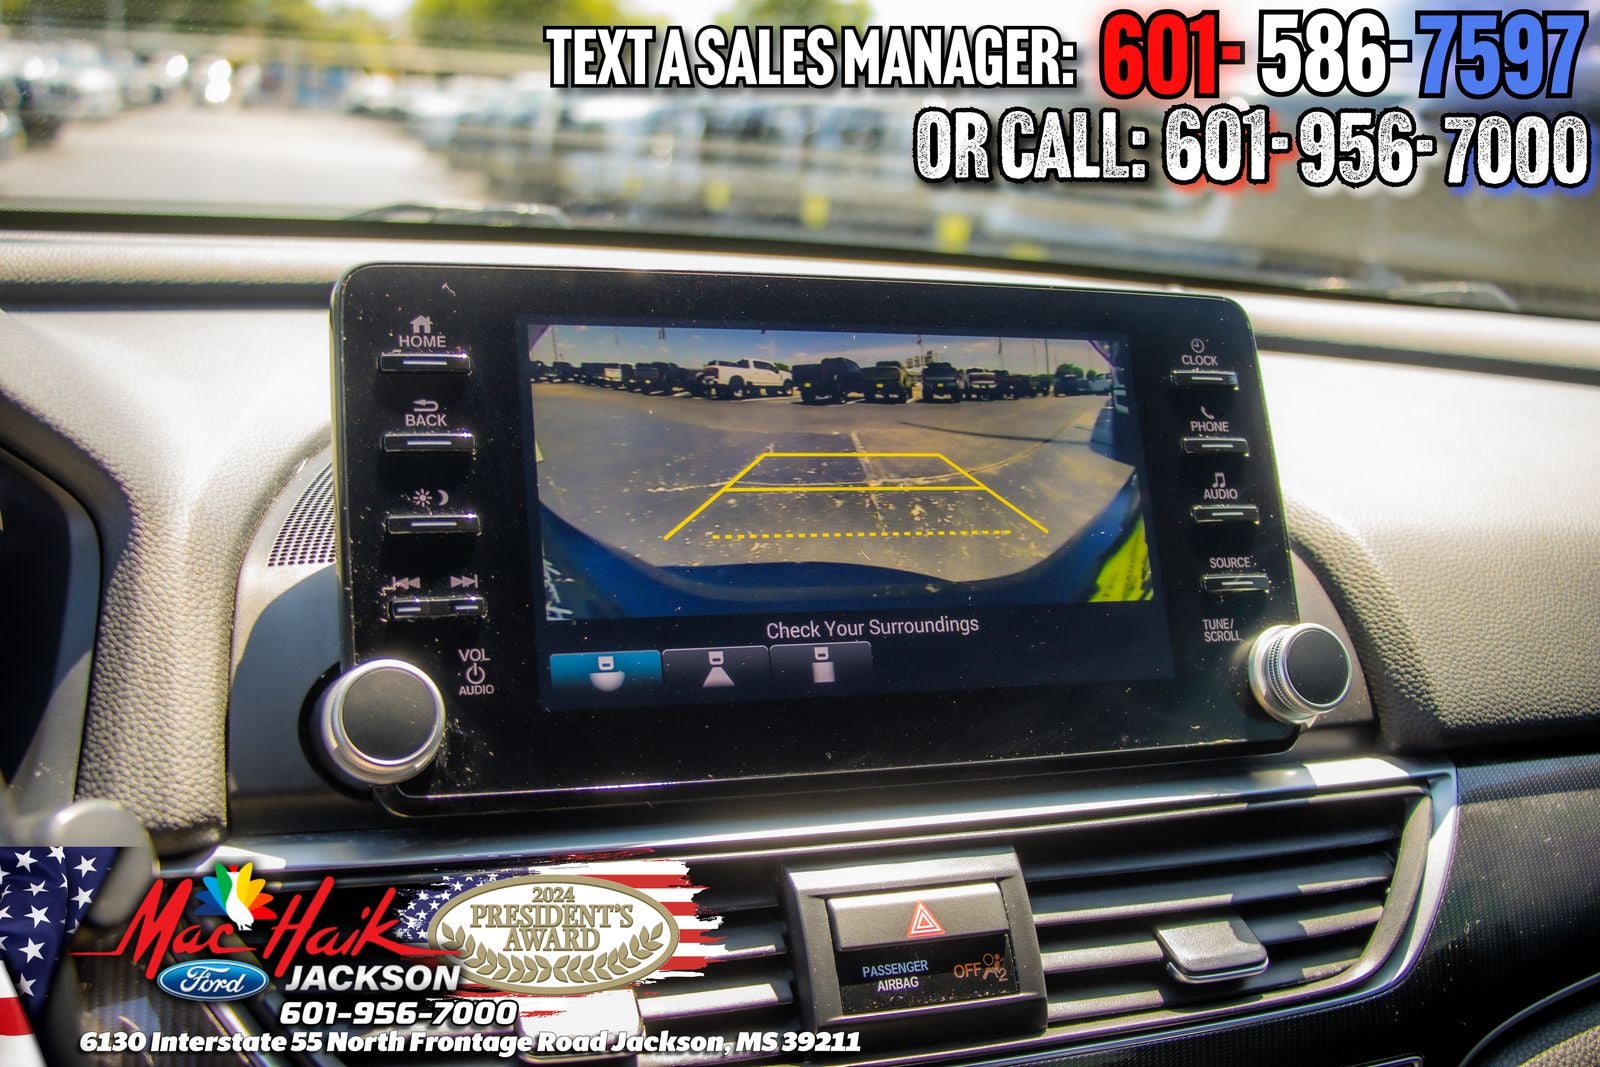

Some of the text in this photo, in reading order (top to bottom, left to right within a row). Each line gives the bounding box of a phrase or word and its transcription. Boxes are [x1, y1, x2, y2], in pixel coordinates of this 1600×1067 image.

[399, 335, 447, 348] HOME
[1181, 354, 1218, 366] CLOCK
[405, 414, 448, 427] BACK
[1190, 421, 1230, 433] PHONE
[1203, 488, 1238, 500] AUDIO
[1209, 557, 1251, 569] SOURCE
[766, 615, 980, 640] Check Your Surroundings
[1202, 618, 1234, 630] TUNE/
[1204, 630, 1243, 642] SCROLL
[458, 648, 491, 662] VOL
[459, 684, 495, 696] AUDIO
[862, 960, 929, 978] PASSENGER
[953, 962, 981, 979] OFF
[877, 976, 919, 992] AIRBAG
